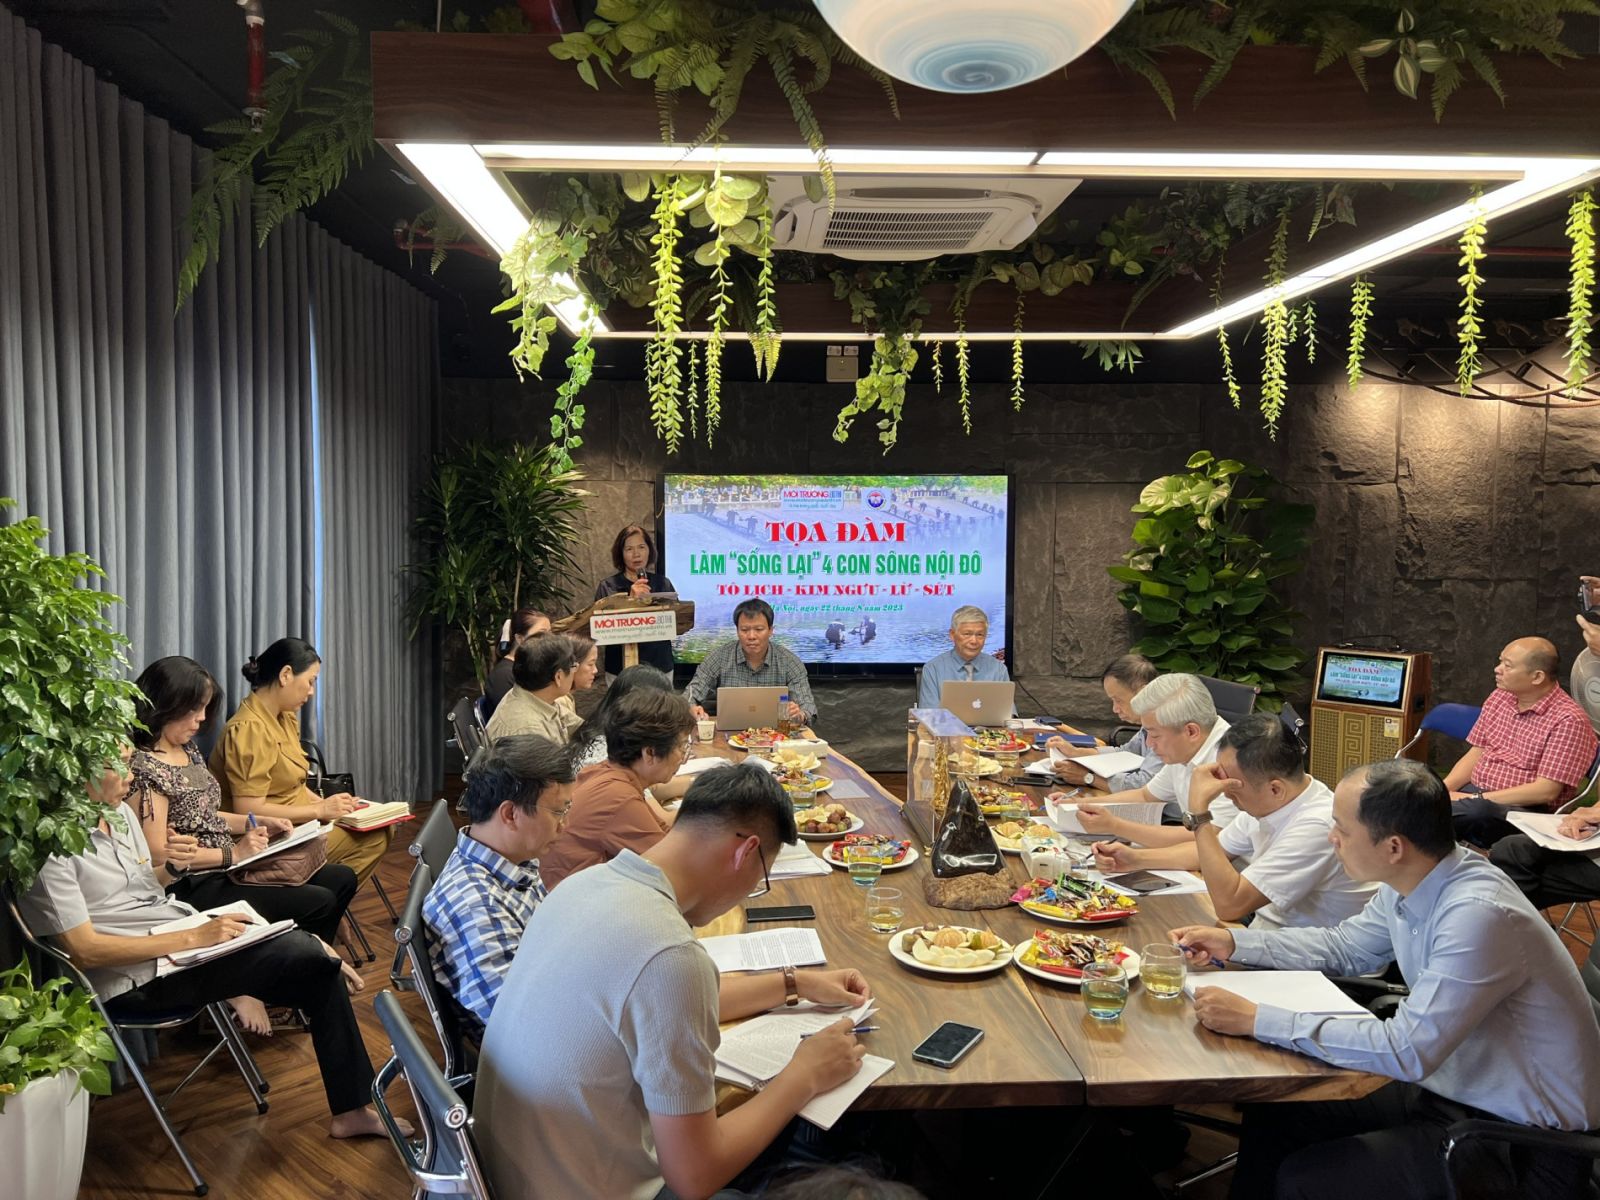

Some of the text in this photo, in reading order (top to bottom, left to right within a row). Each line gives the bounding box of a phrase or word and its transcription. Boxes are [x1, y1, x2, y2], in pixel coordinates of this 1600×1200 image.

[765, 517, 906, 547] TỌA ĐÀM
[690, 550, 726, 575] LÀM
[822, 554, 833, 575] 4
[836, 554, 871, 575] CON
[875, 550, 920, 575] SÔNG
[925, 550, 954, 580] NỘI
[959, 550, 982, 575] ĐÔ
[744, 585, 783, 599] LỊCH
[795, 585, 829, 596] KIM
